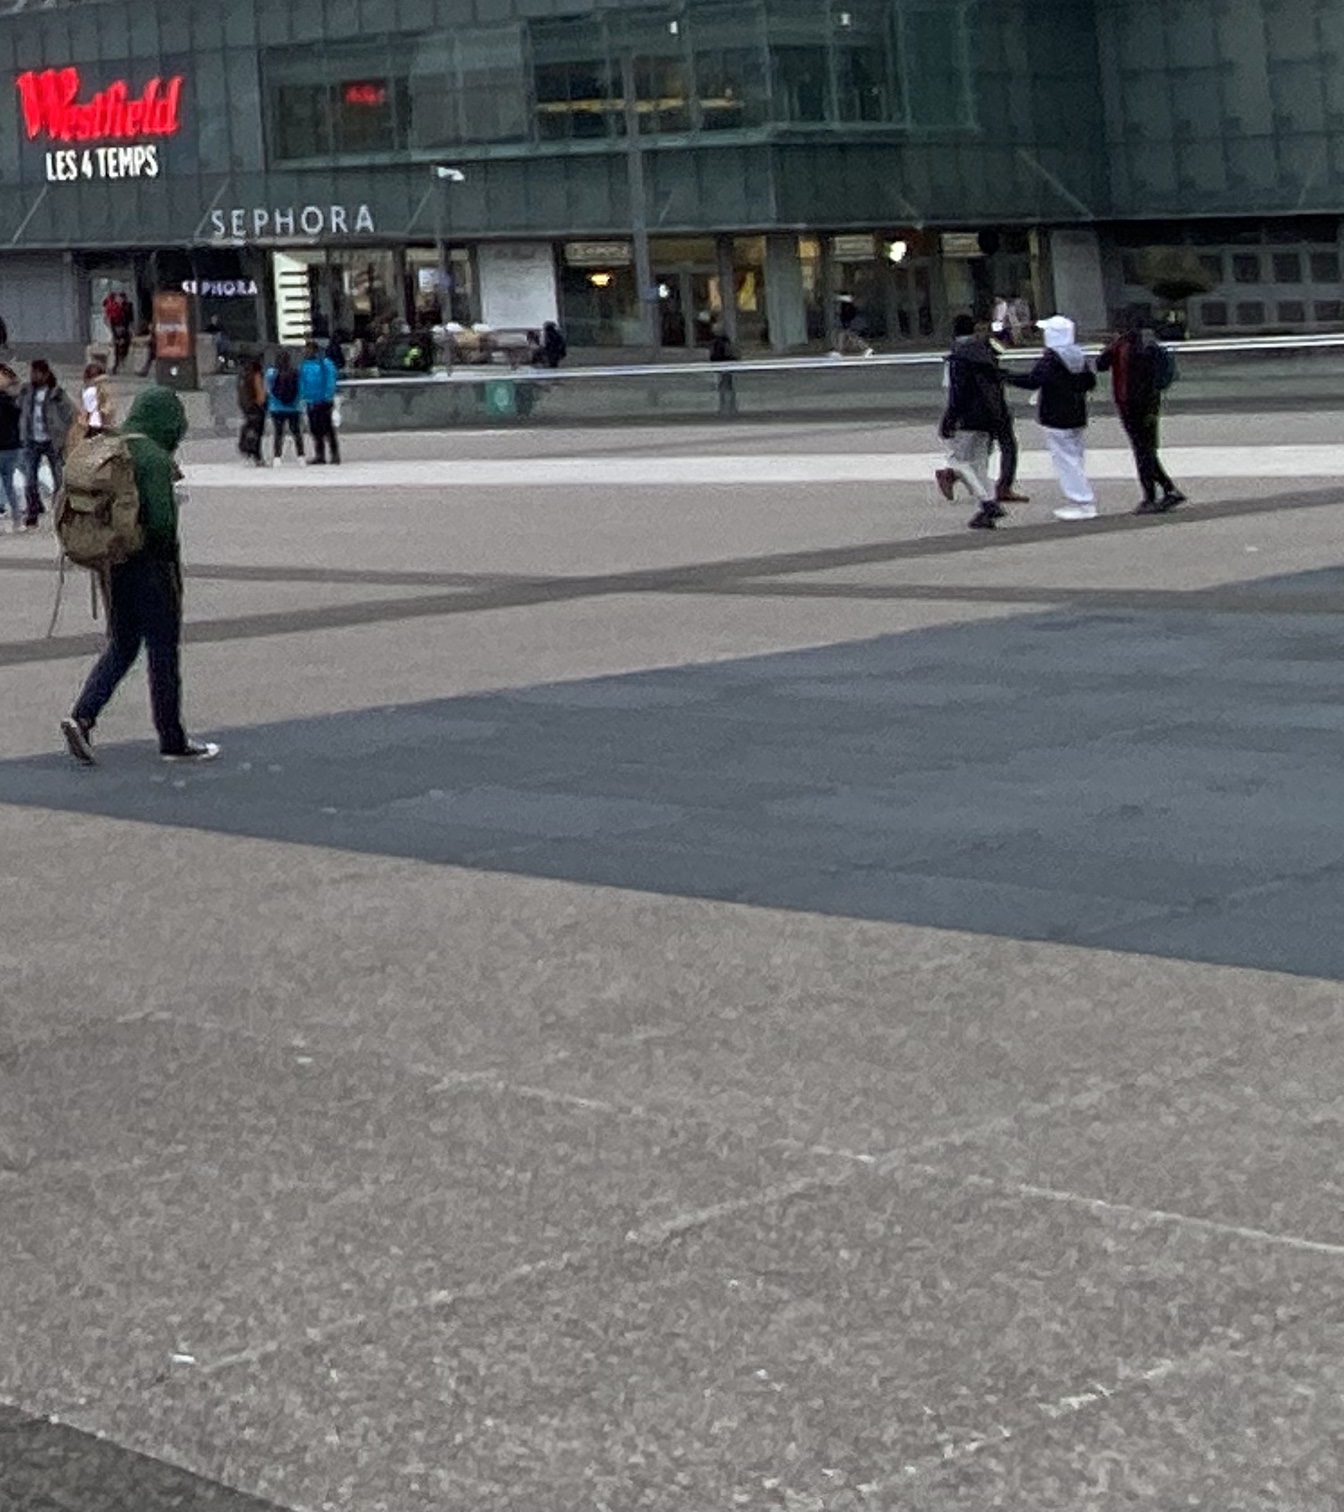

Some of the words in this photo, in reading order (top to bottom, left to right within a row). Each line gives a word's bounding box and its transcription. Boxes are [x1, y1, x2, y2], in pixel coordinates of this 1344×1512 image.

[16, 67, 183, 141] Westfield
[45, 150, 78, 180] LES
[81, 150, 93, 178] 4
[95, 145, 159, 178] TEMPS
[212, 204, 375, 237] SEPHORA
